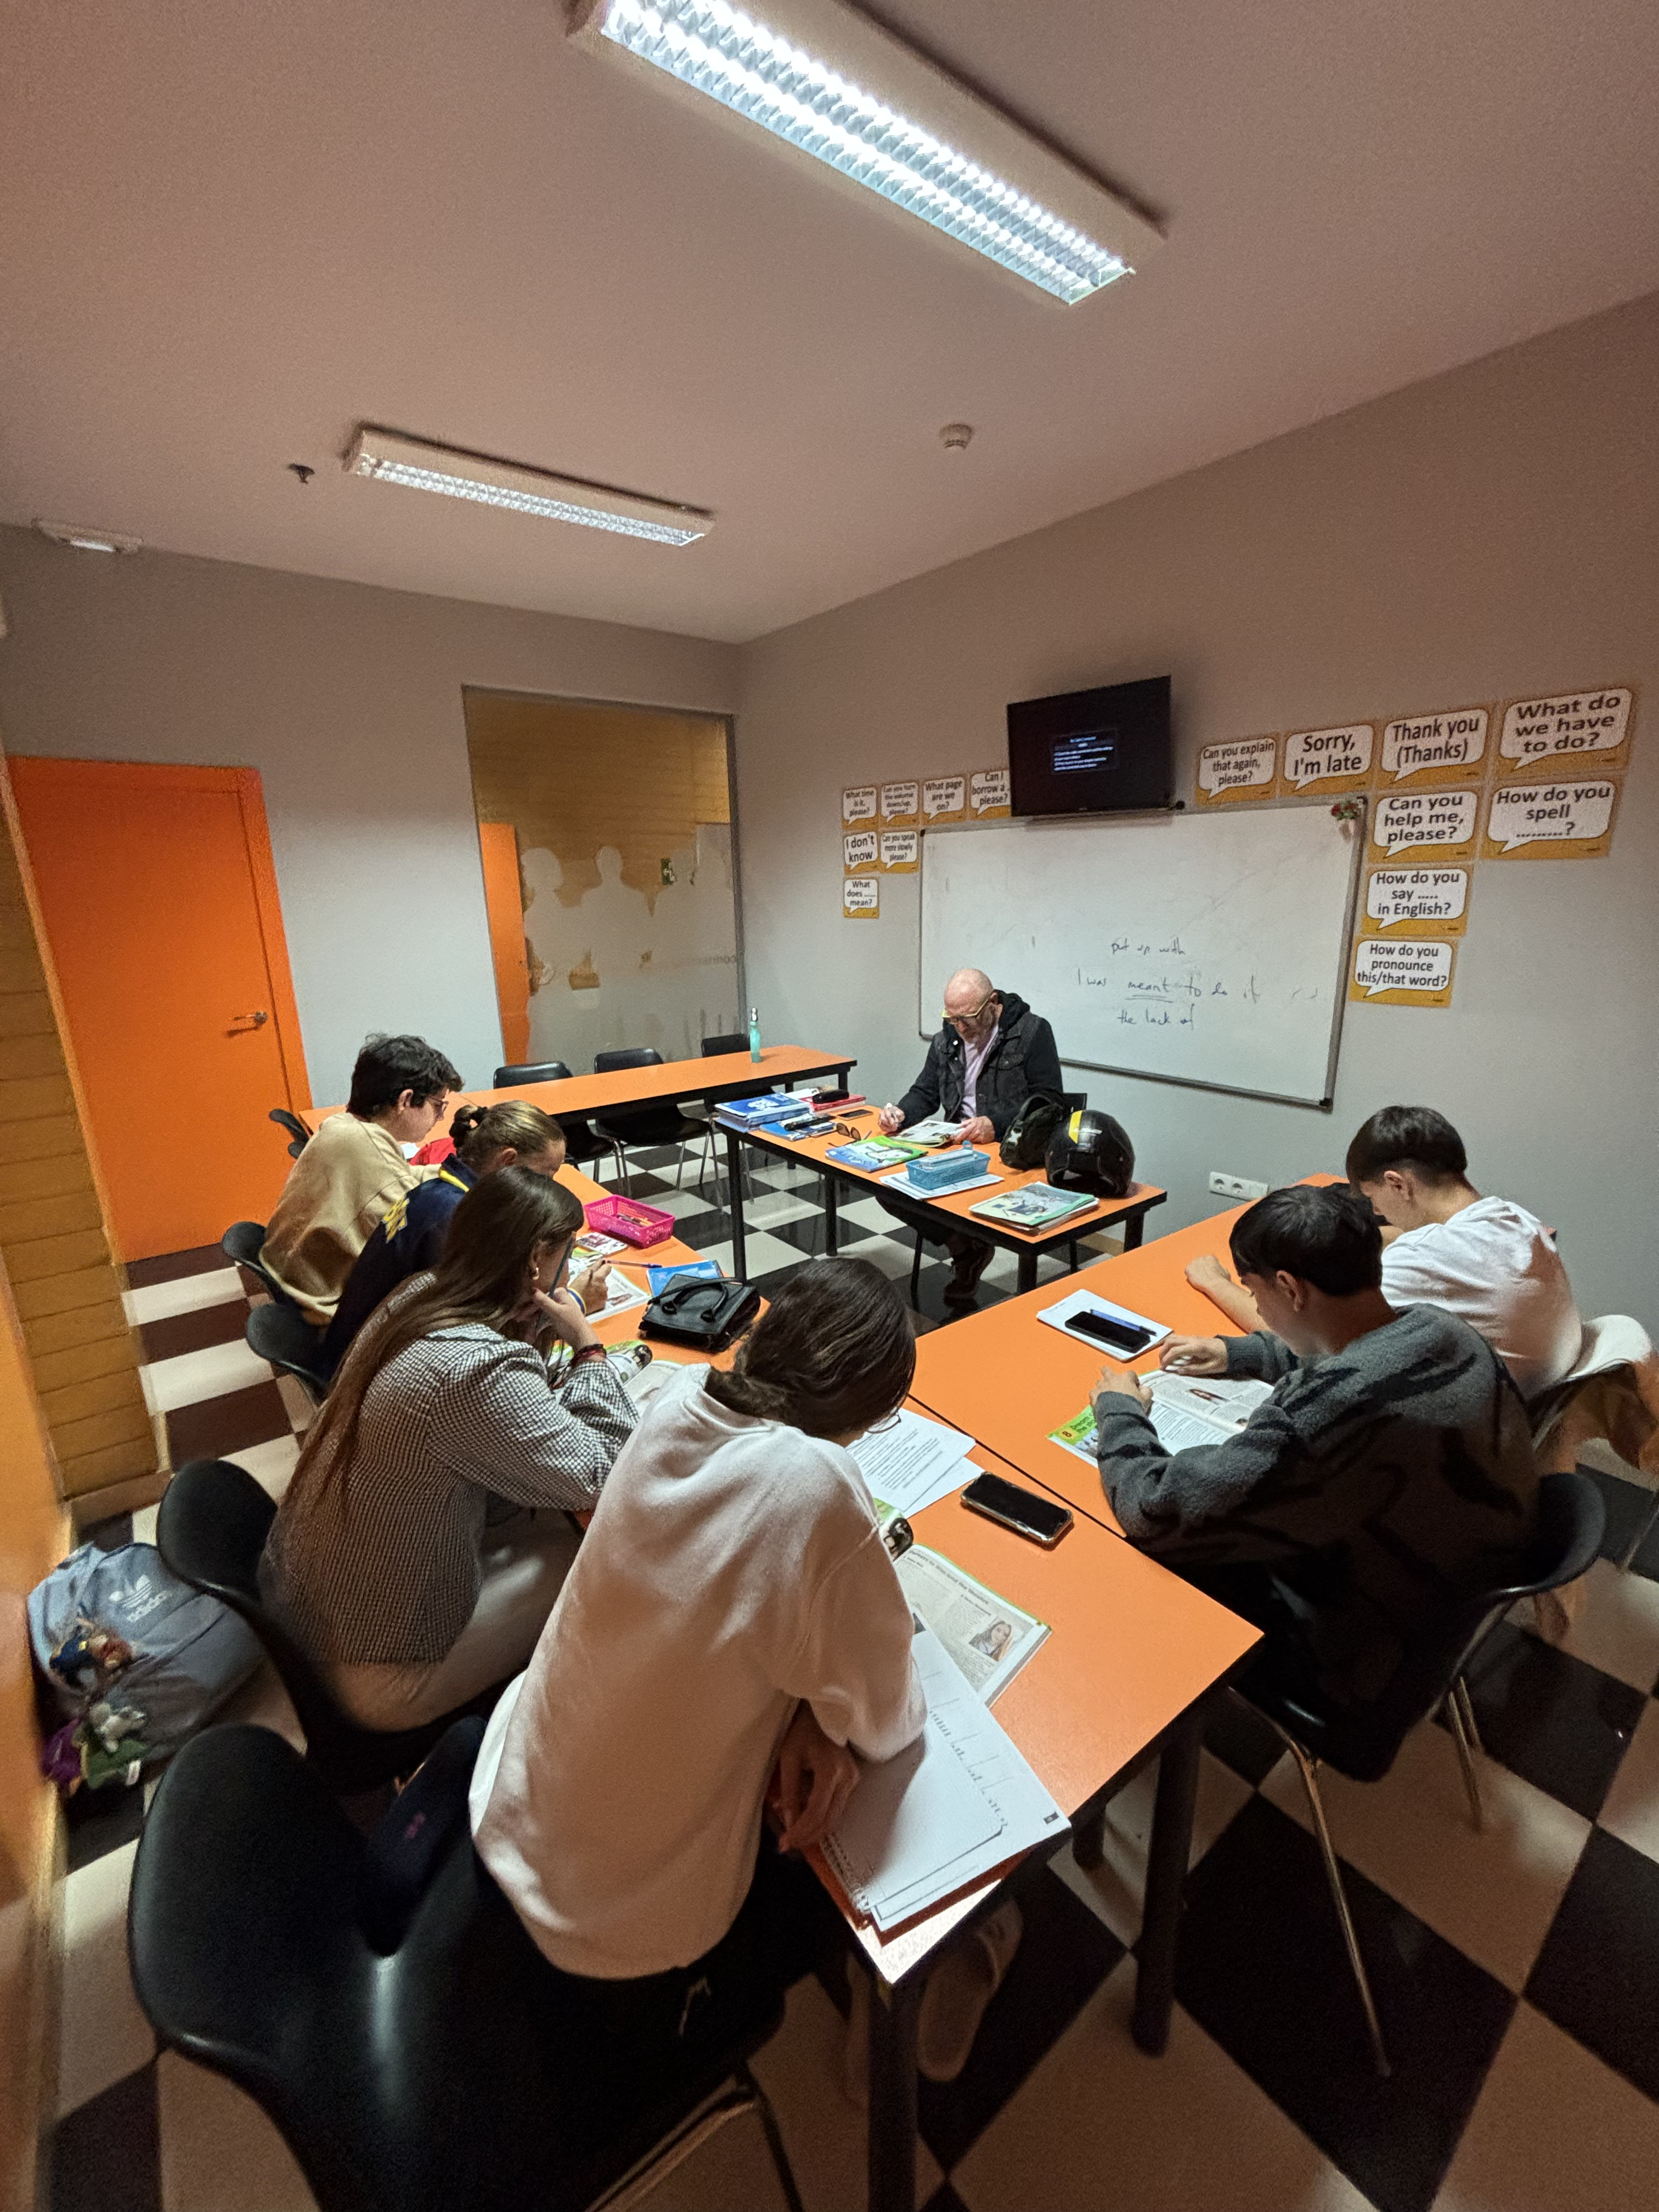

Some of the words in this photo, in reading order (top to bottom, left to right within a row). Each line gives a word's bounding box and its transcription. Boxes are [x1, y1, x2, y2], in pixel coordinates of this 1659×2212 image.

[1517, 700, 1581, 720] What
[1588, 695, 1621, 710] do
[1393, 719, 1444, 742] Thank
[1448, 717, 1480, 737] you
[1515, 724, 1549, 737] we
[1557, 715, 1615, 732] have
[1203, 749, 1219, 759] Can
[1222, 747, 1237, 758] you
[1241, 741, 1274, 754] explain
[1302, 733, 1356, 753] Sorry,
[1524, 741, 1546, 753] to
[1555, 732, 1600, 749] do?
[1397, 740, 1468, 768] (Thanks)
[1212, 761, 1231, 772] that
[1294, 759, 1321, 776] I'm
[1327, 754, 1362, 772] late
[985, 773, 999, 782] Can
[1218, 771, 1253, 786] please?
[925, 783, 944, 791] What
[945, 781, 962, 790] page
[972, 783, 998, 795] borrow
[932, 793, 943, 802] are
[979, 793, 1008, 806] please?
[1497, 792, 1538, 804] How
[1544, 787, 1568, 801] do
[1573, 787, 1611, 803] you
[936, 801, 950, 811] on?
[1389, 798, 1422, 811] Can
[1429, 796, 1463, 810] you
[1385, 814, 1423, 828] help
[1429, 813, 1464, 826] me,
[1526, 805, 1571, 821] spell
[846, 840, 849, 849] I
[851, 834, 874, 848] don't
[891, 834, 901, 843] you
[1387, 826, 1458, 844] please?
[898, 843, 913, 853] slowly
[849, 851, 873, 862] know
[889, 852, 907, 861] please?
[1376, 873, 1407, 884] How
[1411, 872, 1429, 883] do
[1434, 873, 1460, 885] you
[1391, 890, 1414, 901] say
[1378, 904, 1389, 915] in
[1394, 902, 1451, 917] English?
[1111, 938, 1129, 955] put
[1137, 945, 1150, 955] up
[1160, 937, 1186, 955] with
[1370, 944, 1395, 955] How
[1399, 945, 1413, 955] do
[1417, 949, 1438, 958] you
[1372, 960, 1434, 972] pronounce
[1087, 978, 1107, 987] was
[1128, 977, 1170, 992] meant
[1184, 976, 1201, 997] to
[1357, 972, 1405, 985] this/that
[1409, 975, 1447, 987] word?
[1118, 1010, 1137, 1025] the
[1146, 1009, 1171, 1025] lack
[1180, 1003, 1195, 1030] of
